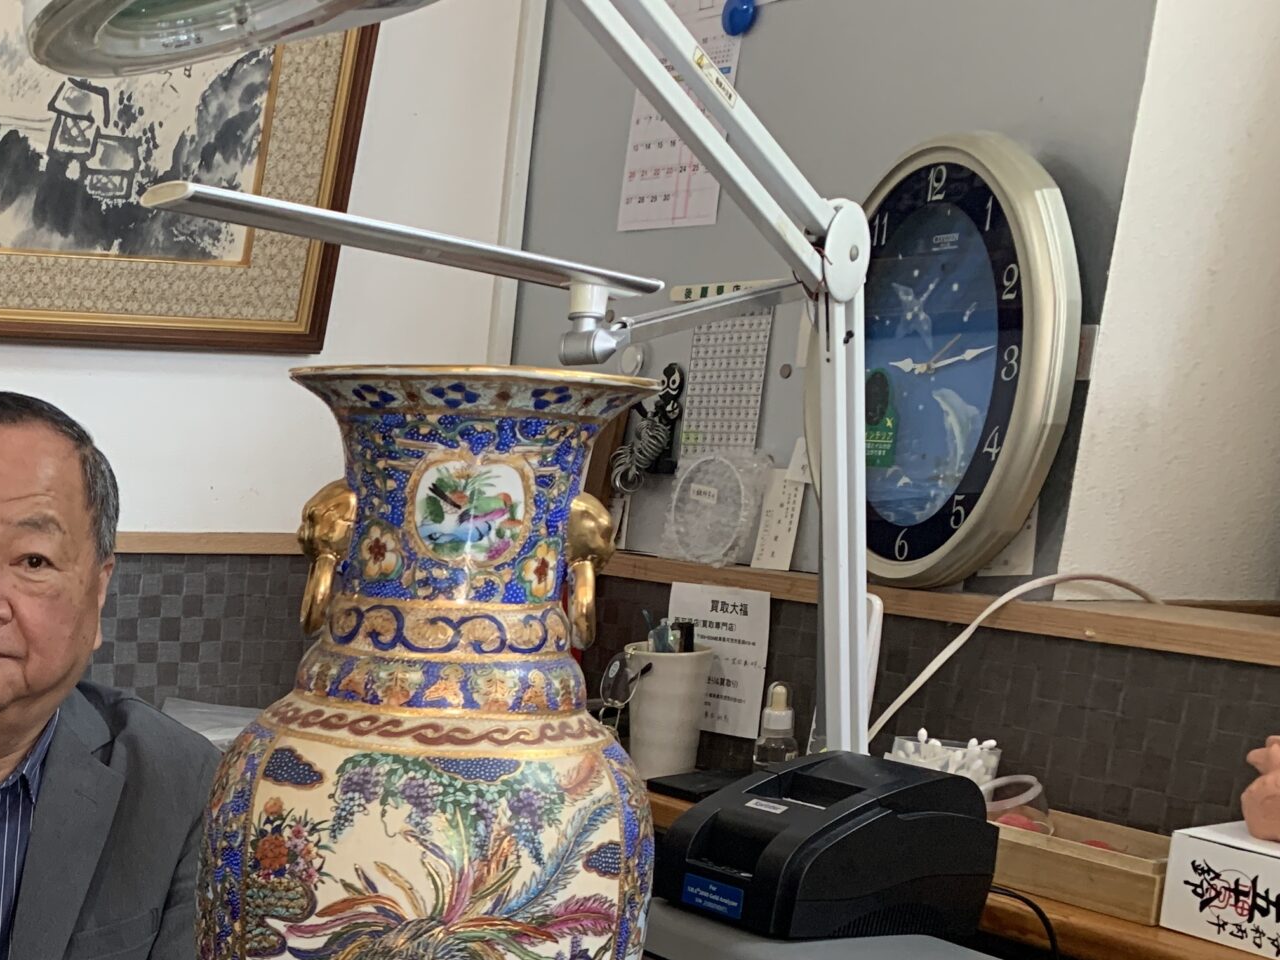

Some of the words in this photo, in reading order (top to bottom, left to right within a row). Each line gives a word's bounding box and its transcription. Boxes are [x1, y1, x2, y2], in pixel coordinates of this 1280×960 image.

[927, 165, 948, 202] 12
[872, 212, 889, 247] 11
[985, 195, 994, 232] 1
[933, 232, 960, 244] CITIZEN
[1002, 263, 1019, 301] 2
[1001, 344, 1019, 381] 3
[983, 426, 1001, 461] 4
[950, 494, 966, 530] 5
[894, 527, 909, 561] 6
[709, 599, 749, 617] 買取大福
